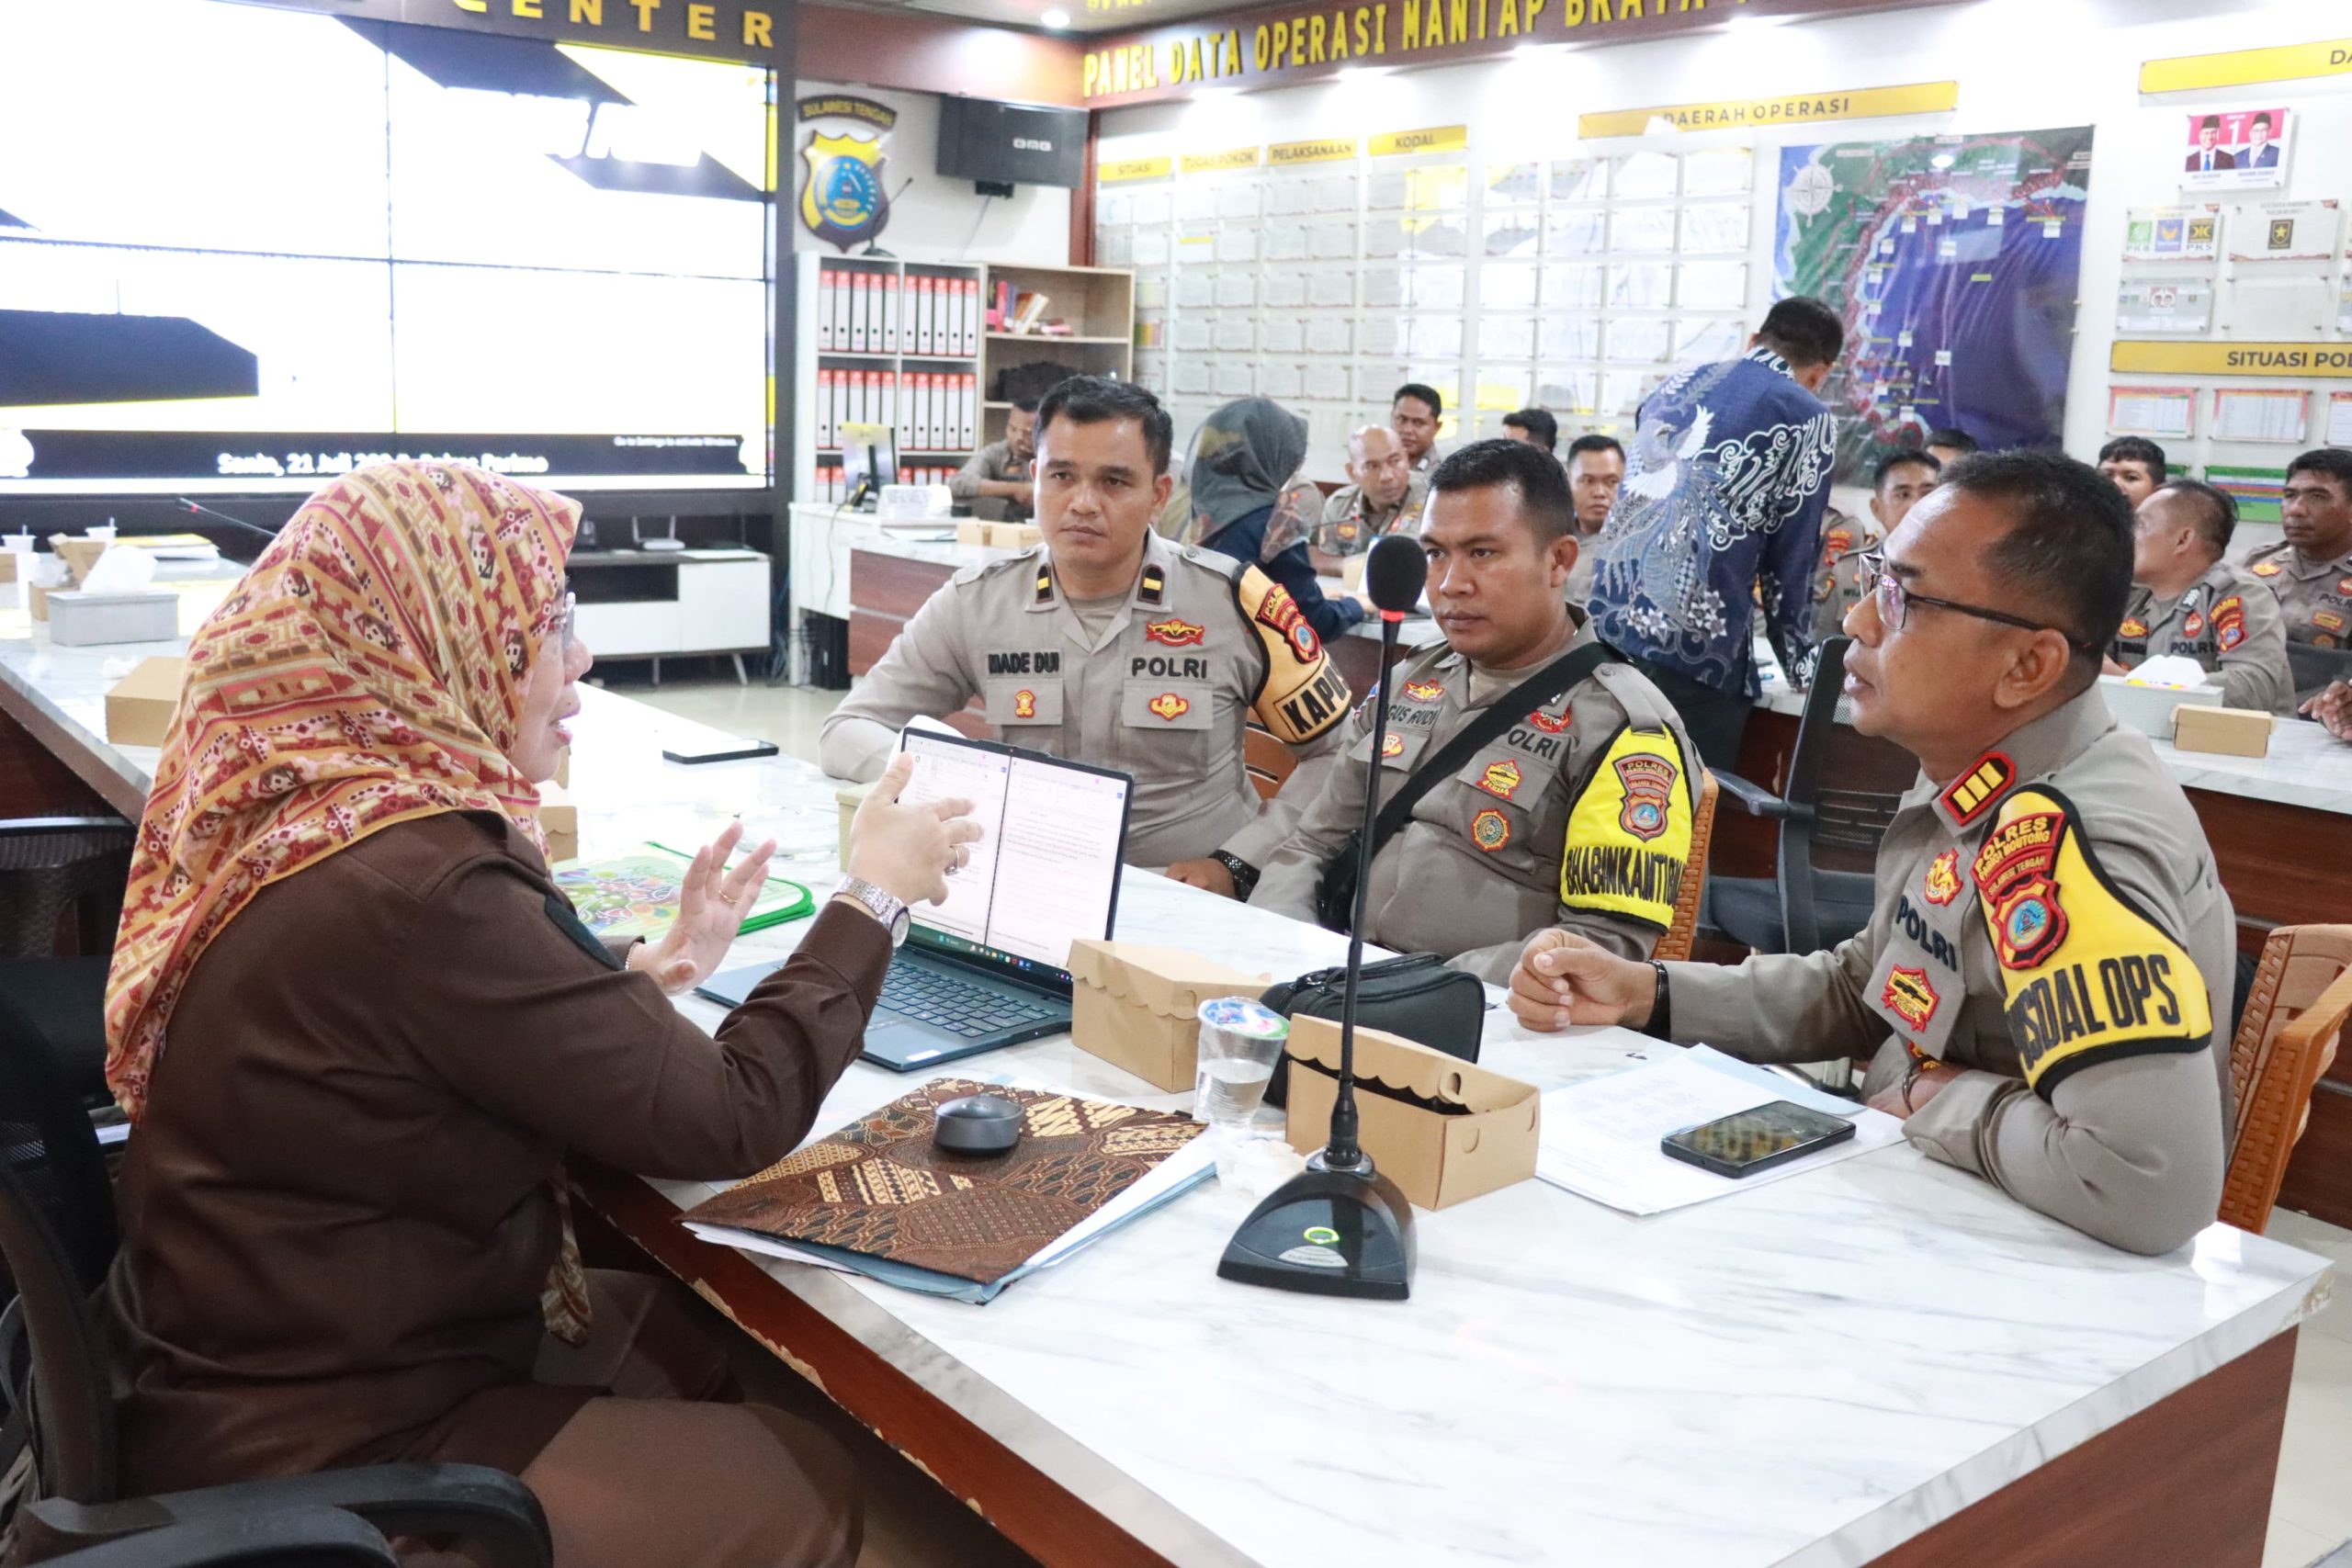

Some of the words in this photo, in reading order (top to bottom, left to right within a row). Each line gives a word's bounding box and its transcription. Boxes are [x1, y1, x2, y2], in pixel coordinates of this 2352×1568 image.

[1083, 45, 1159, 97] PANEL
[1169, 29, 1241, 85] DATA
[1253, 5, 1387, 72] OPERASI
[1664, 107, 1745, 125] DAERAH
[1754, 97, 1849, 118] OPERASI
[1272, 143, 1352, 161] PELAKSANAAN
[1395, 133, 1436, 150] KODAL
[2227, 351, 2307, 367] SITUASI
[988, 652, 1030, 674] MADE
[1132, 657, 1207, 679] POLRI
[1283, 658, 1350, 735] KAPO
[1387, 704, 1412, 722] GUS
[1508, 728, 1562, 761] OLRI
[1974, 816, 2048, 873] POLRES
[2017, 855, 2046, 872] TENGAH
[1895, 895, 1957, 972] POLRI
[2007, 963, 2108, 1072] SDAL
[2098, 953, 2182, 1029] OPS
